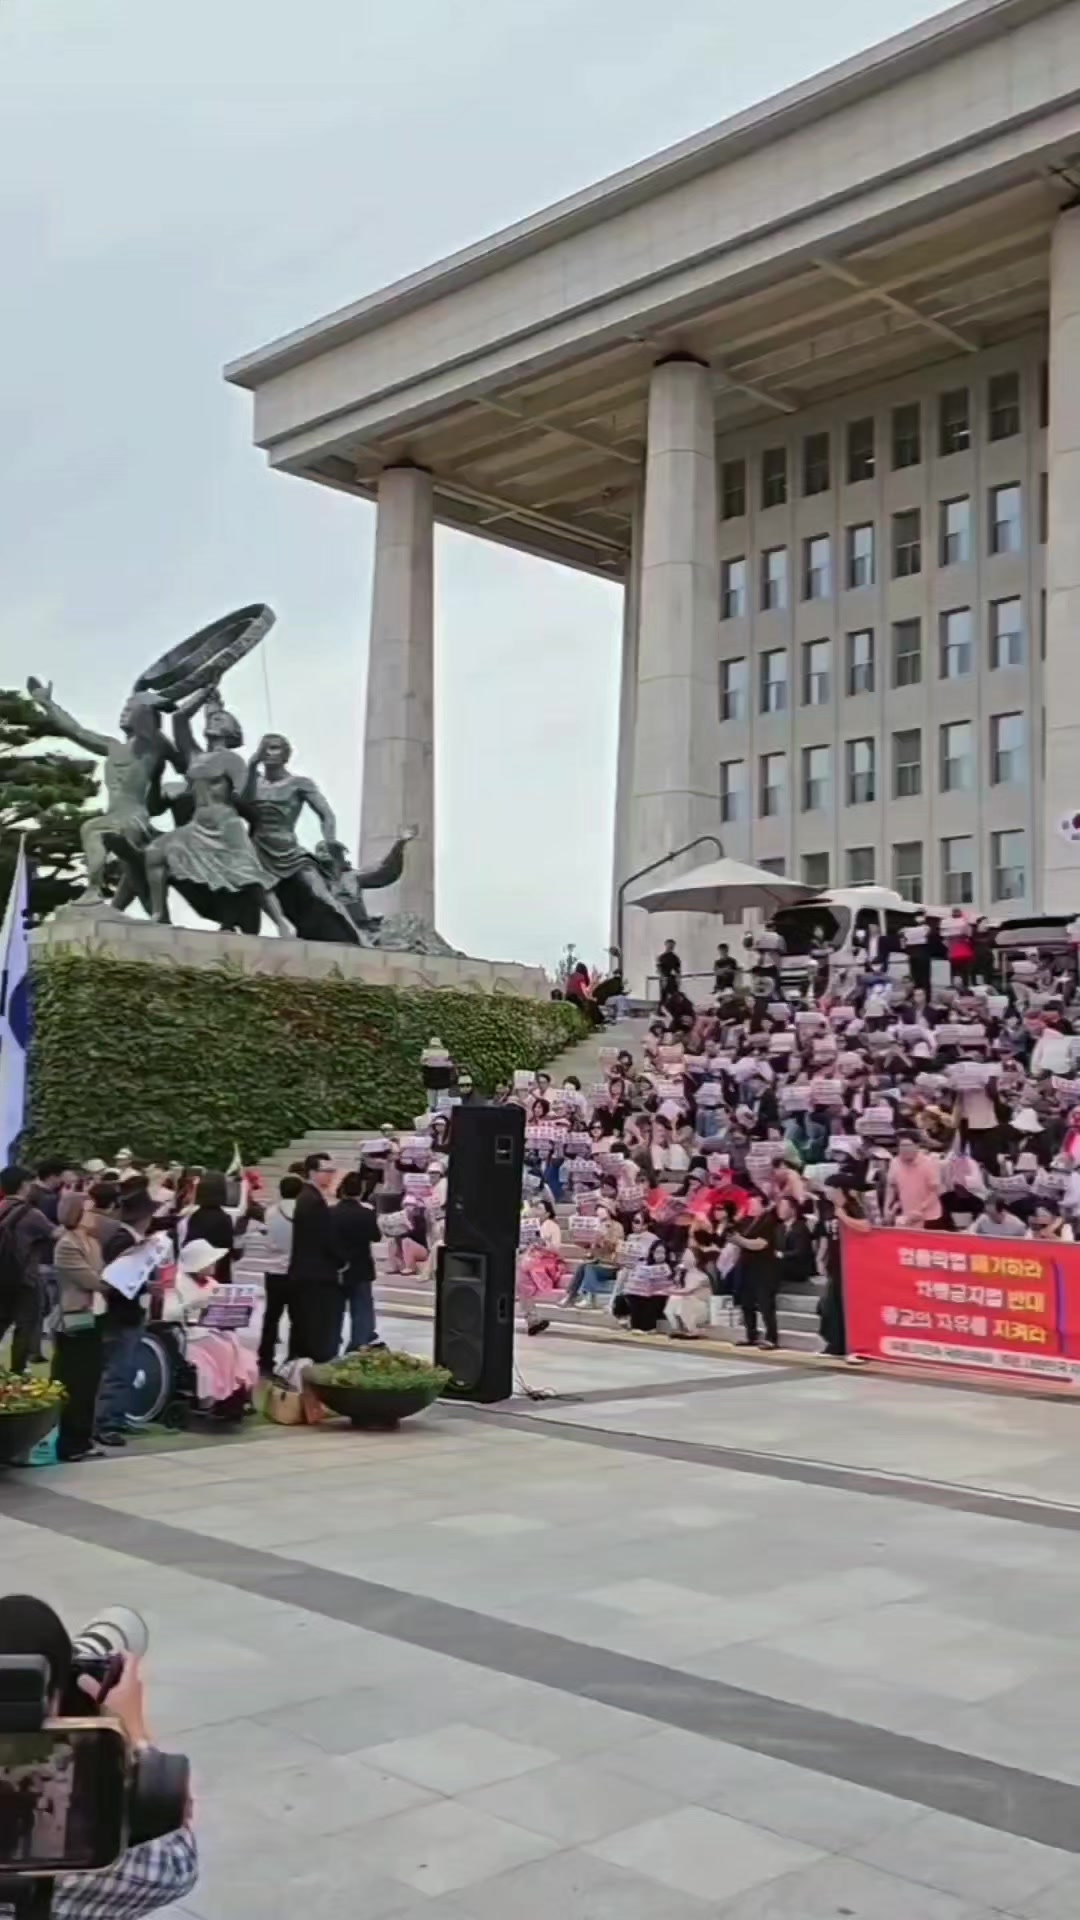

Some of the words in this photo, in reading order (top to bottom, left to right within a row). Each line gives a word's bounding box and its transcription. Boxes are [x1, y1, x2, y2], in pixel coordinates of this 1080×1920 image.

[915, 1280, 1003, 1308] 차별금지법
[1007, 1290, 1045, 1313] 반대
[881, 1306, 932, 1329] 종교의
[934, 1312, 988, 1337] 자유를
